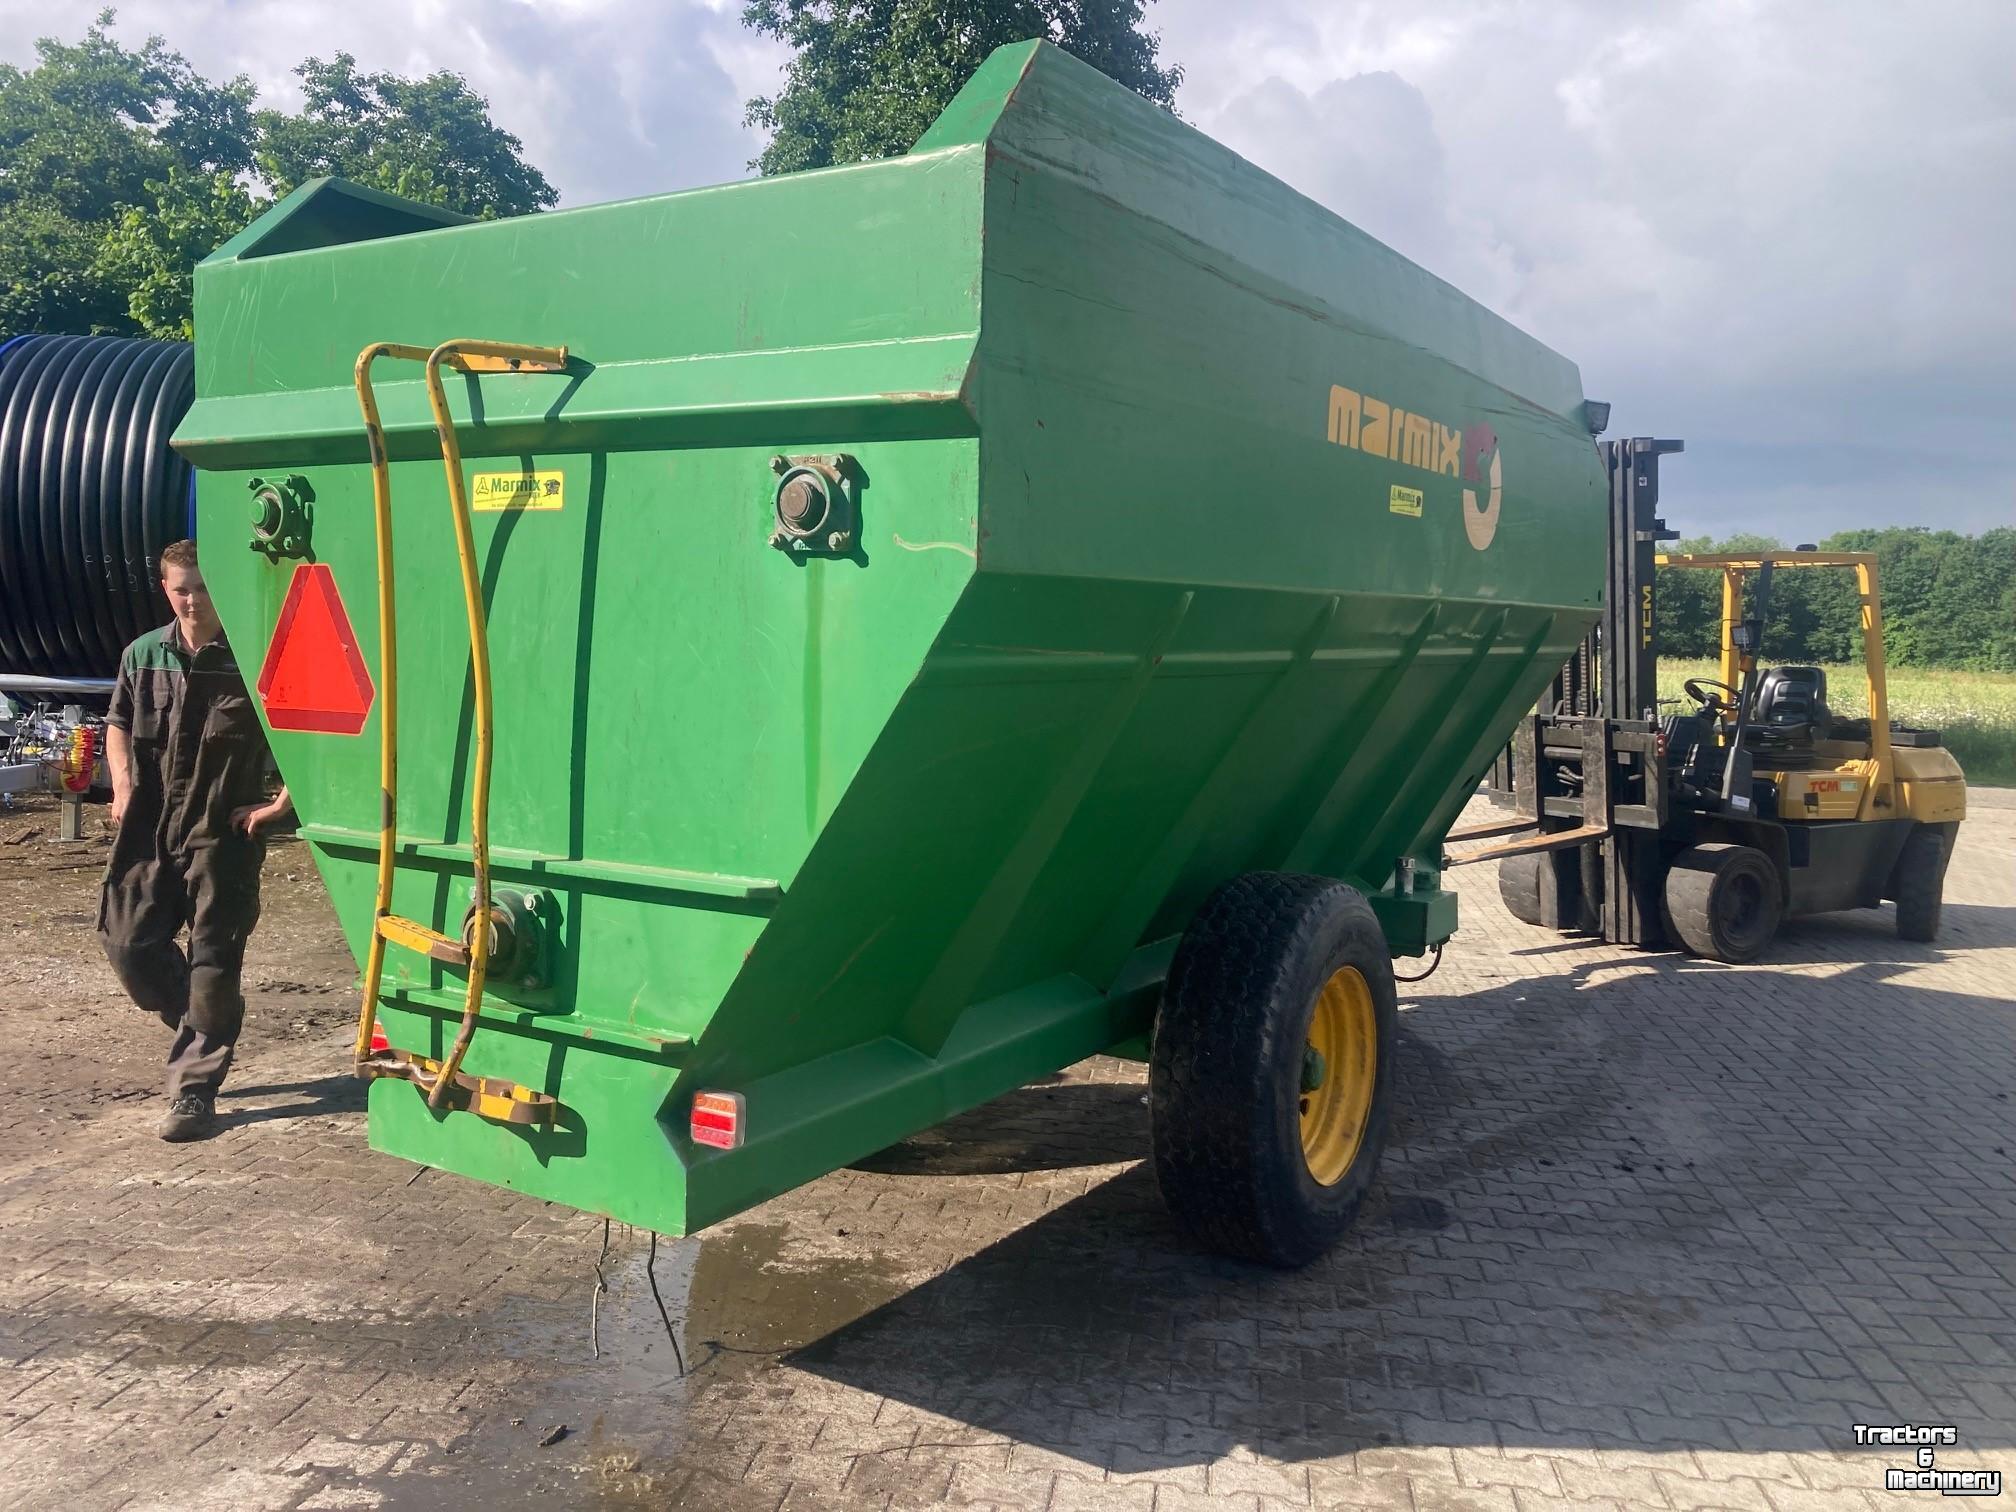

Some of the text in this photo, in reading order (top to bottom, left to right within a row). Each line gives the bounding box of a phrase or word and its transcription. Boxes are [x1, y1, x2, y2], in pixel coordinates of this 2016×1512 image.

[490, 475, 541, 492] Marmix
[1642, 585, 1652, 650] TCM
[1808, 780, 1839, 792] TCM
